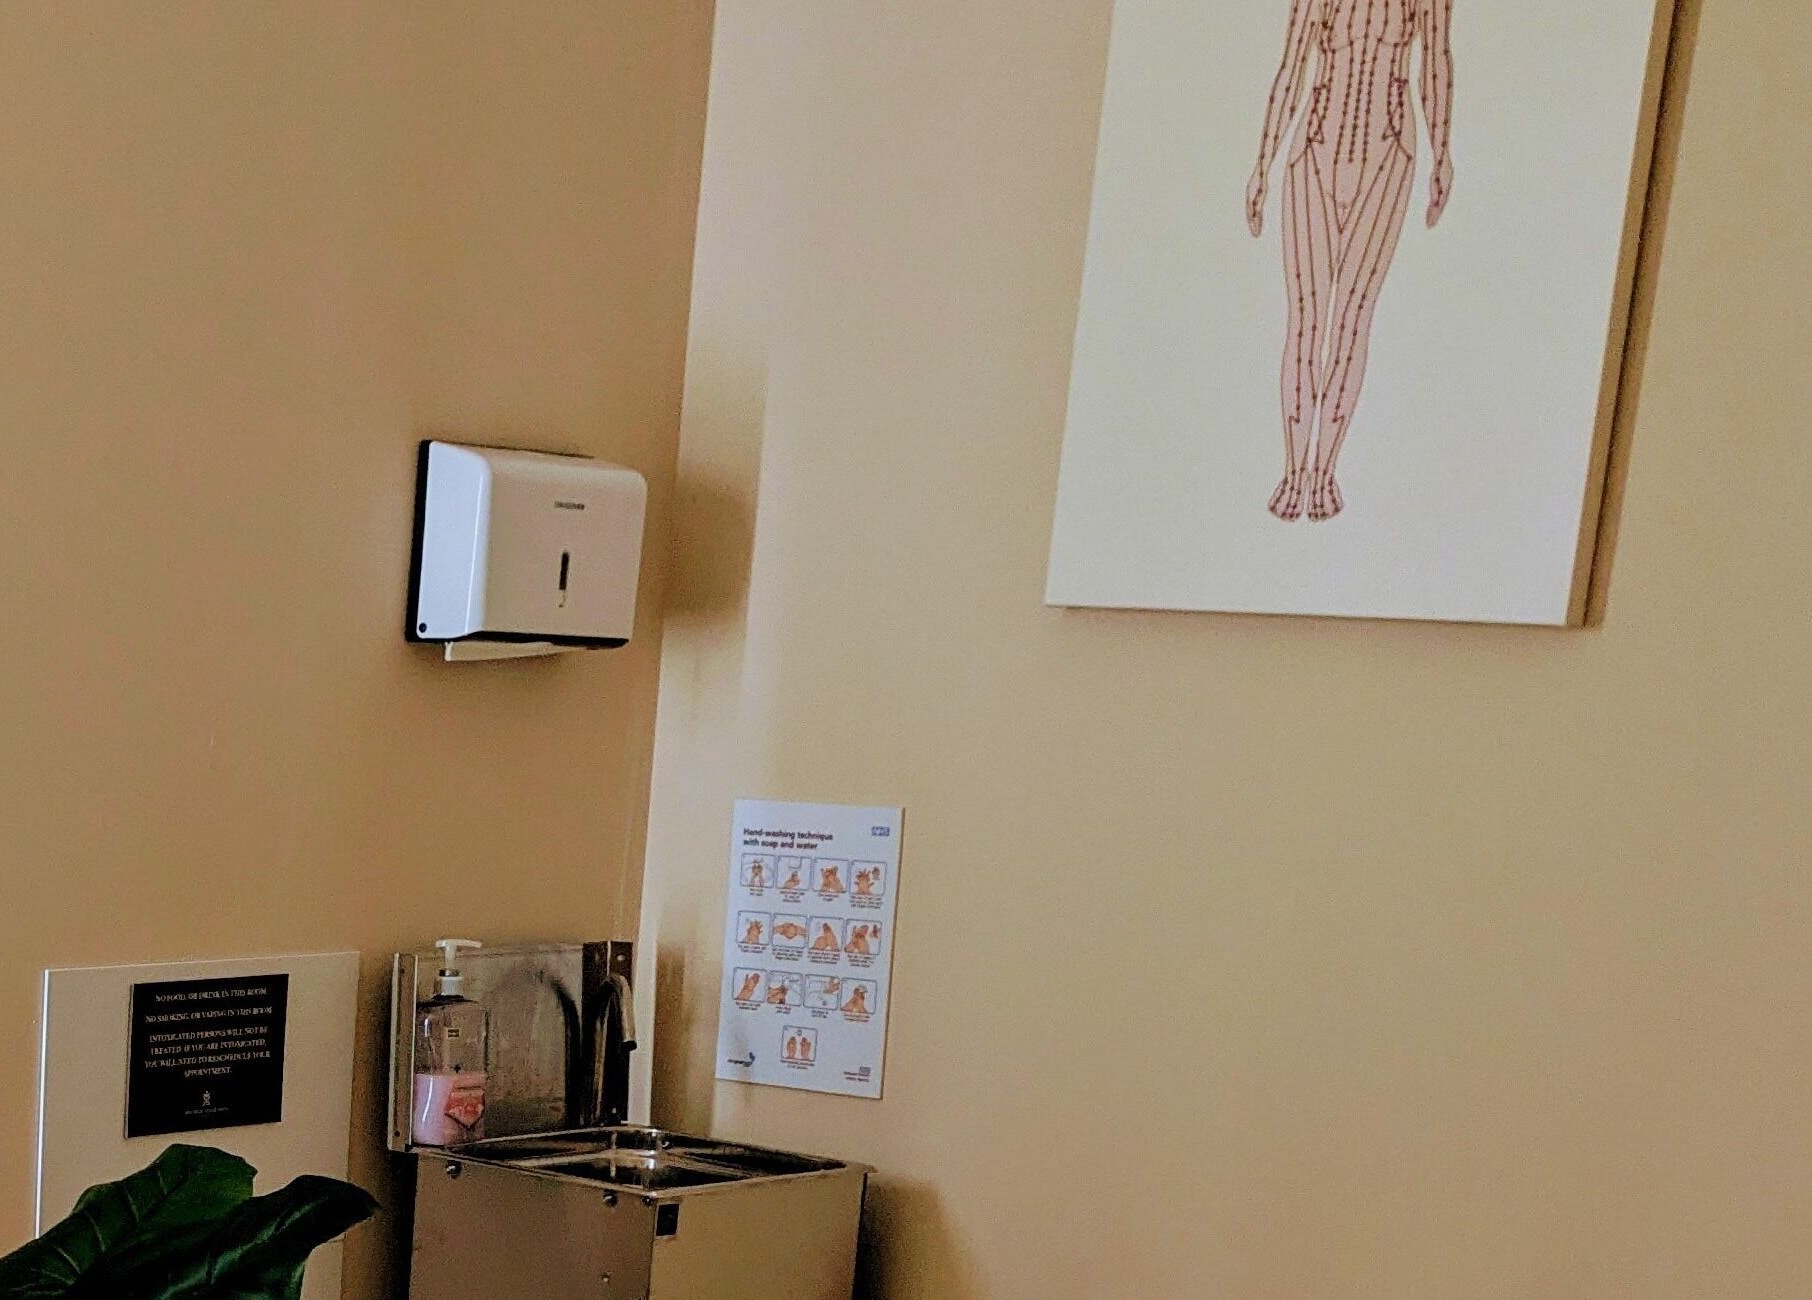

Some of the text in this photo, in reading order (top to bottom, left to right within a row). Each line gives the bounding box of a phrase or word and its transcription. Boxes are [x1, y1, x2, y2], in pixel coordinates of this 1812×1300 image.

[743, 828, 834, 841] Hand-washing technique
[156, 994, 166, 1002] NO
[145, 1015, 156, 1023] NO
[191, 1012, 201, 1020] OR
[149, 1032, 196, 1043] INTOXICATED
[196, 1029, 226, 1040] PERSONS
[206, 1042, 218, 1050] ARE
